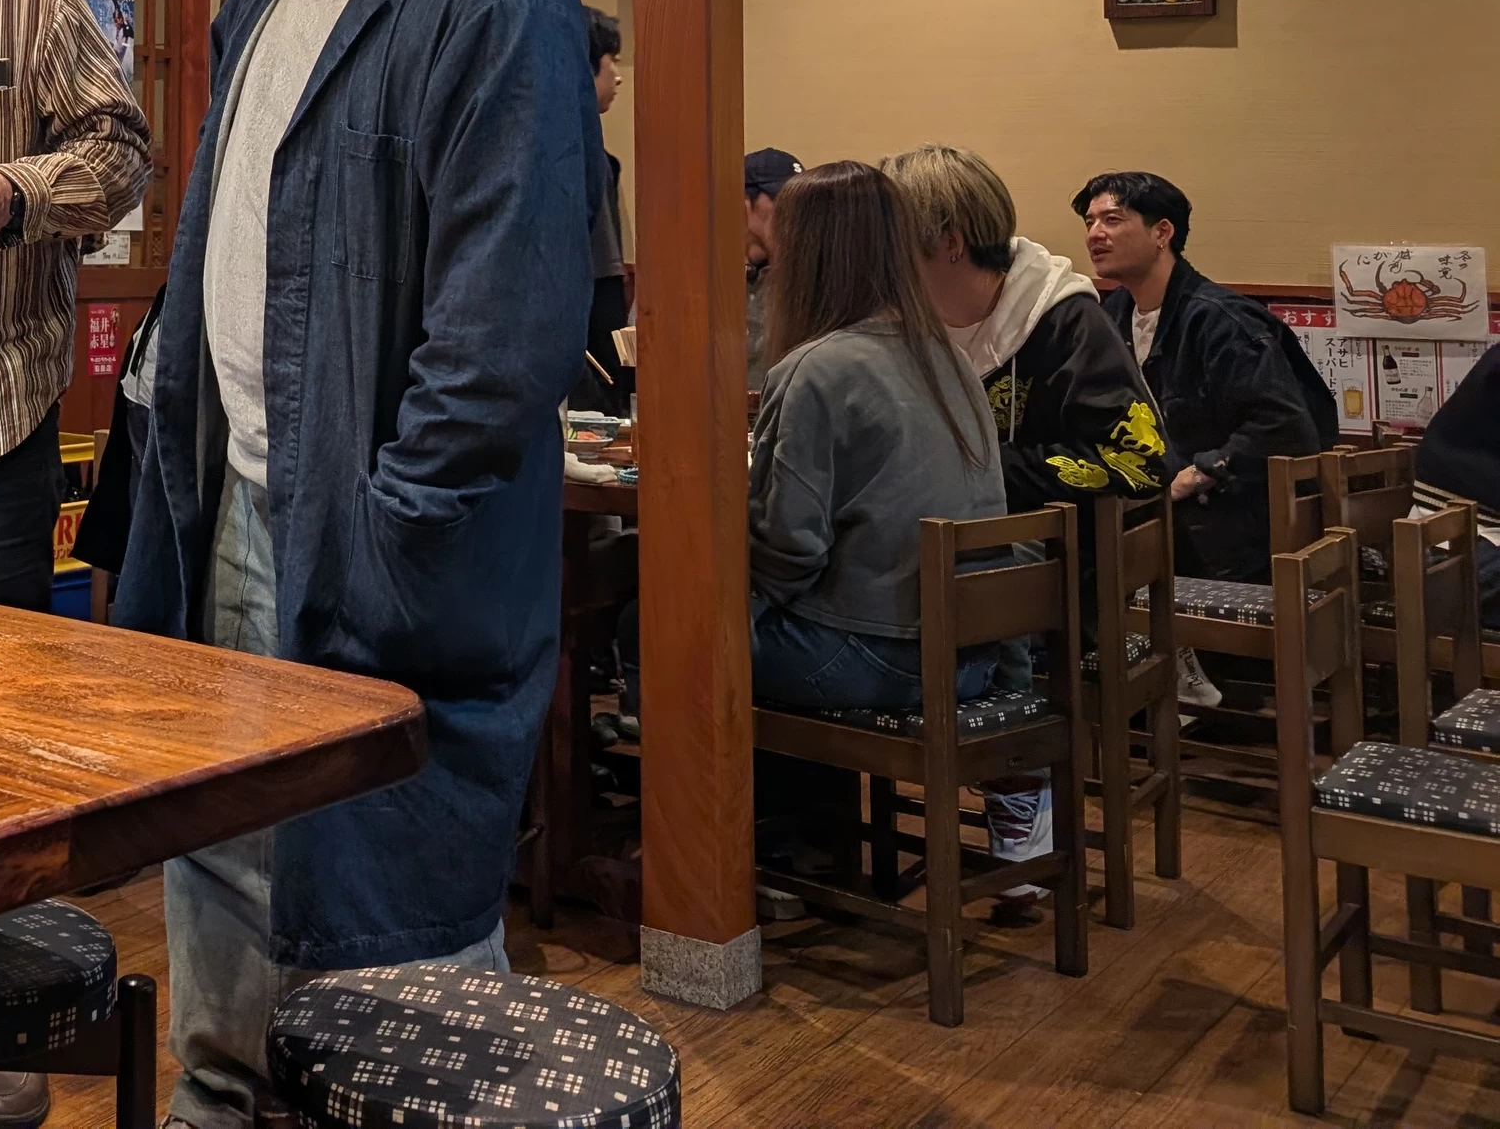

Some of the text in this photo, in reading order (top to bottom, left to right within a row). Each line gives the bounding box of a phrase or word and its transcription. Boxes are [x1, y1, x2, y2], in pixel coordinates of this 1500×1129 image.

[90, 317, 110, 333] 福井
[1282, 308, 1336, 327] おすす
[90, 334, 109, 349] 赤星
[1337, 338, 1349, 368] アサヒ
[1325, 337, 1338, 399] スーパードラ
